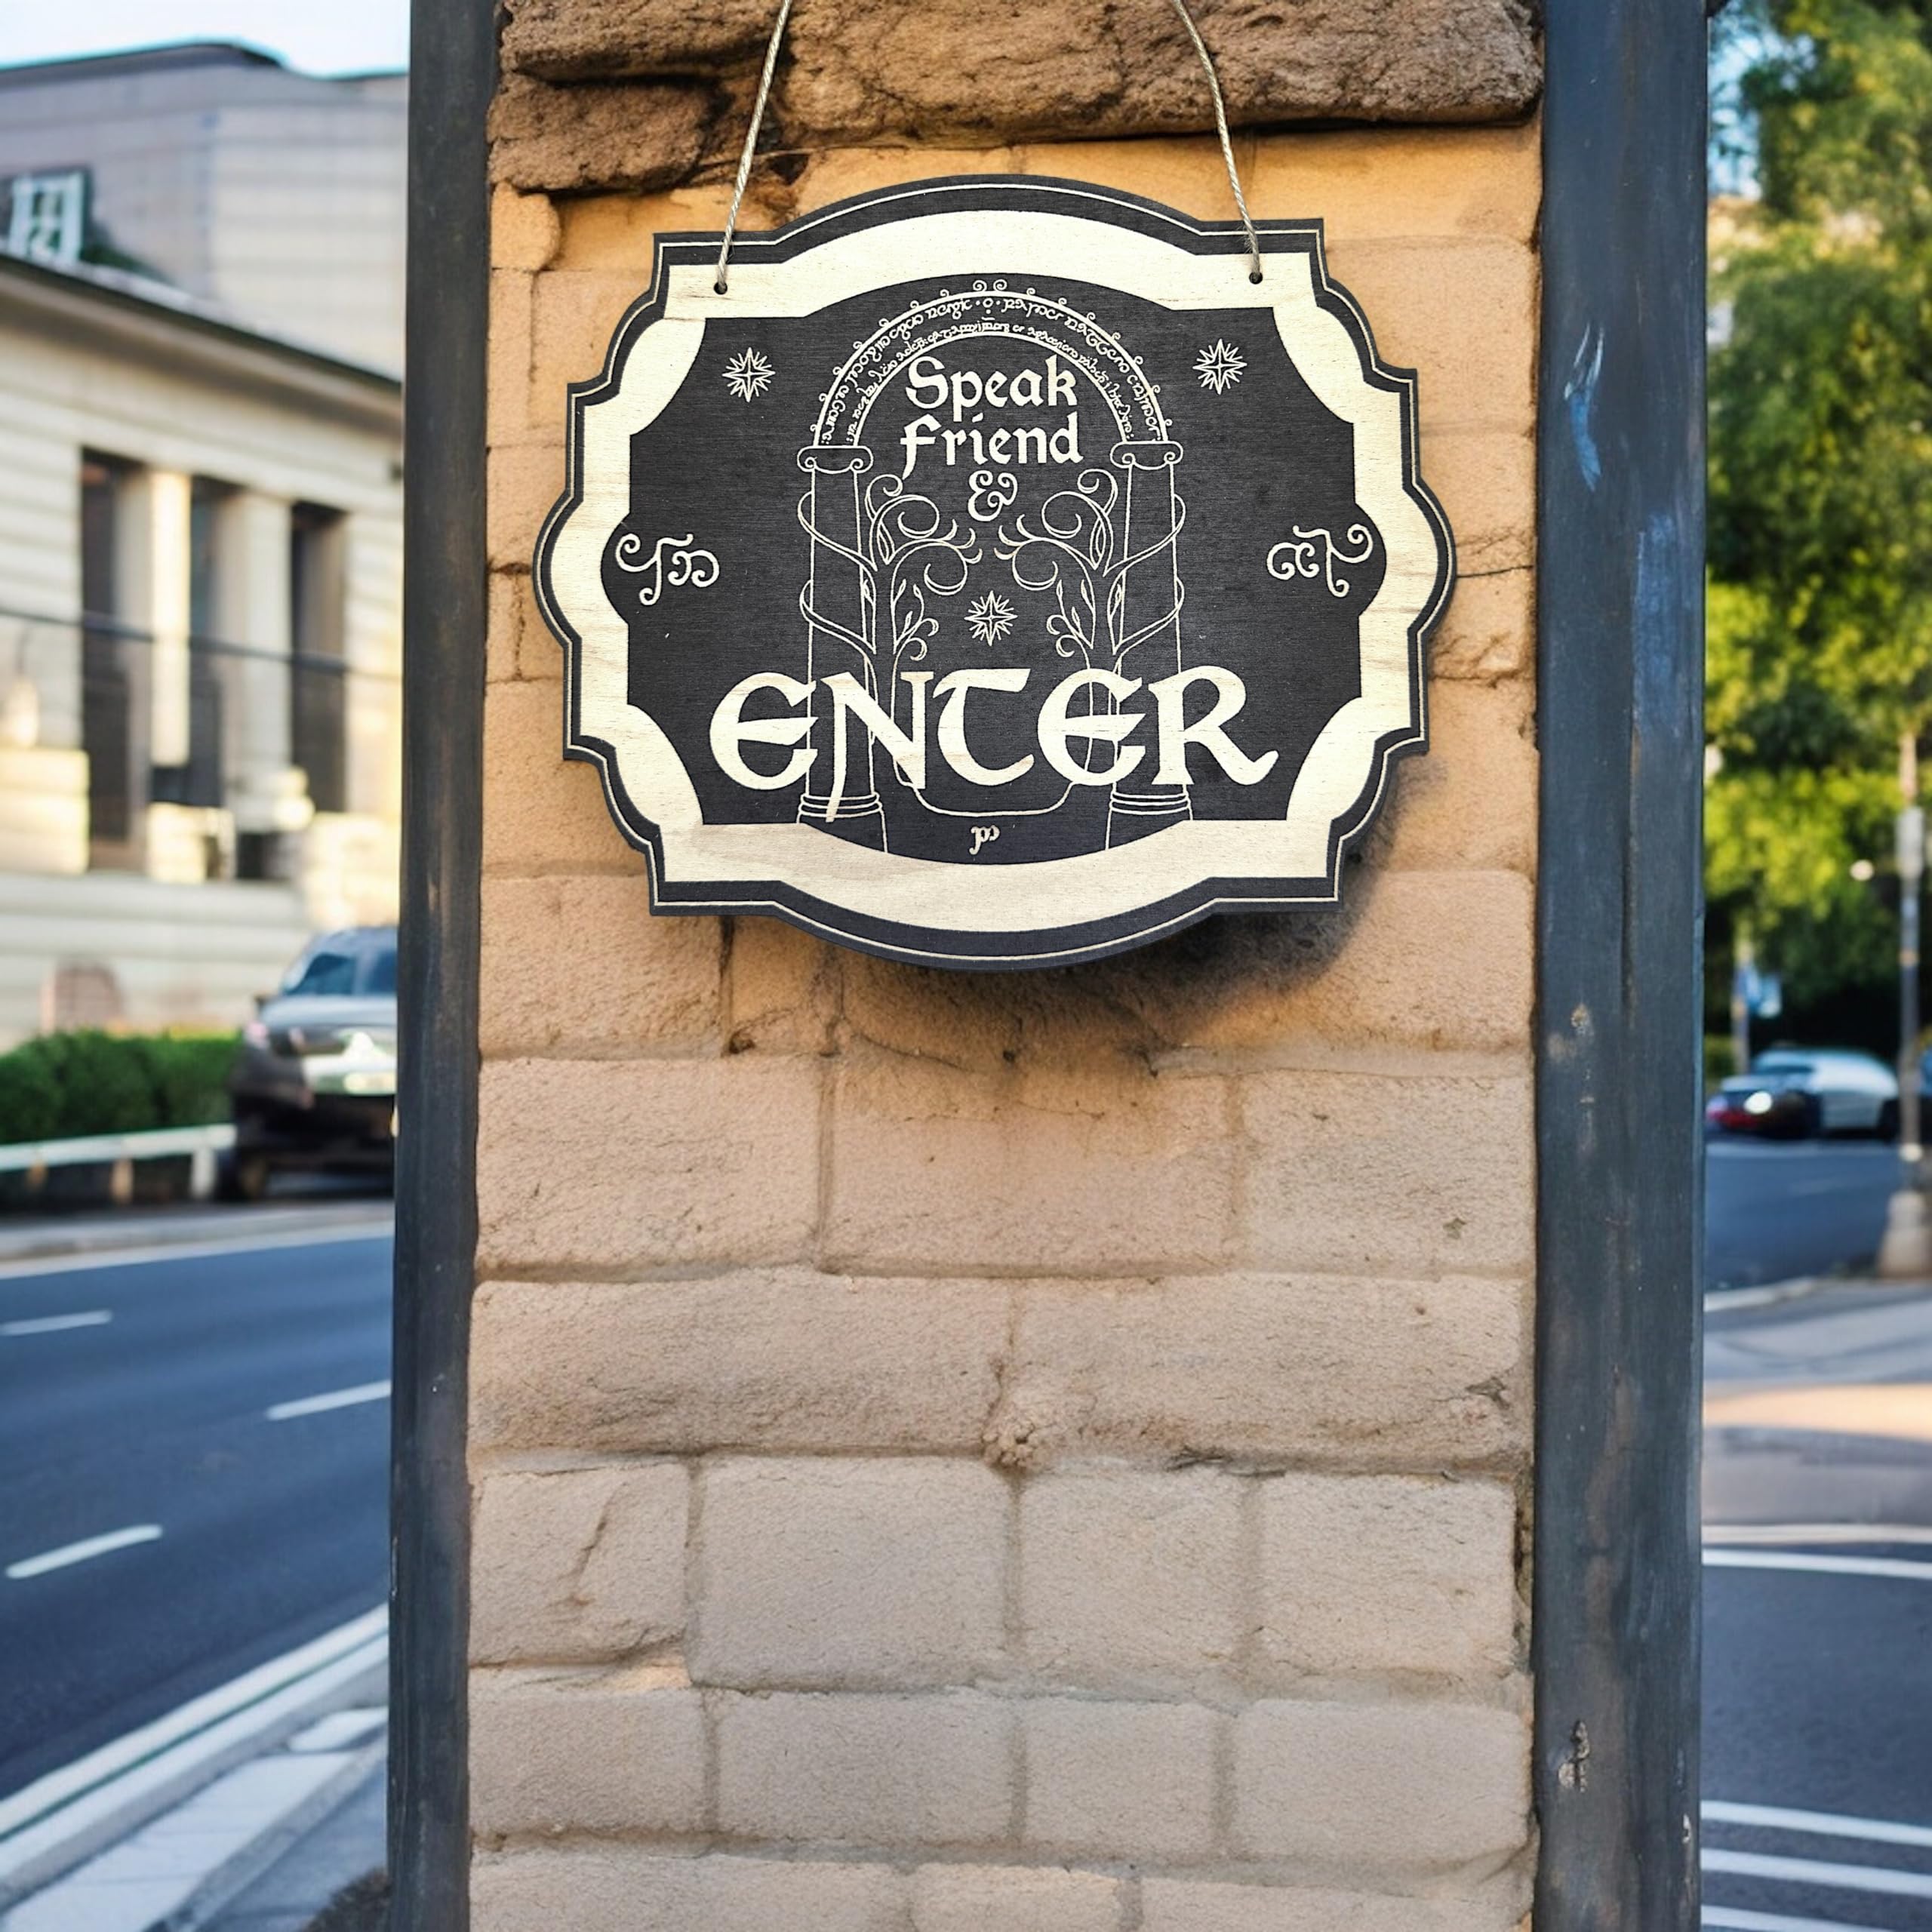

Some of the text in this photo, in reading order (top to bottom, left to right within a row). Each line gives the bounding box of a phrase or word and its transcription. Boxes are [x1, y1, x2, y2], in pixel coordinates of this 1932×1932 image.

[906, 355, 1078, 422] Speak
[968, 469, 1018, 521] &
[709, 666, 1279, 823] ENTER
